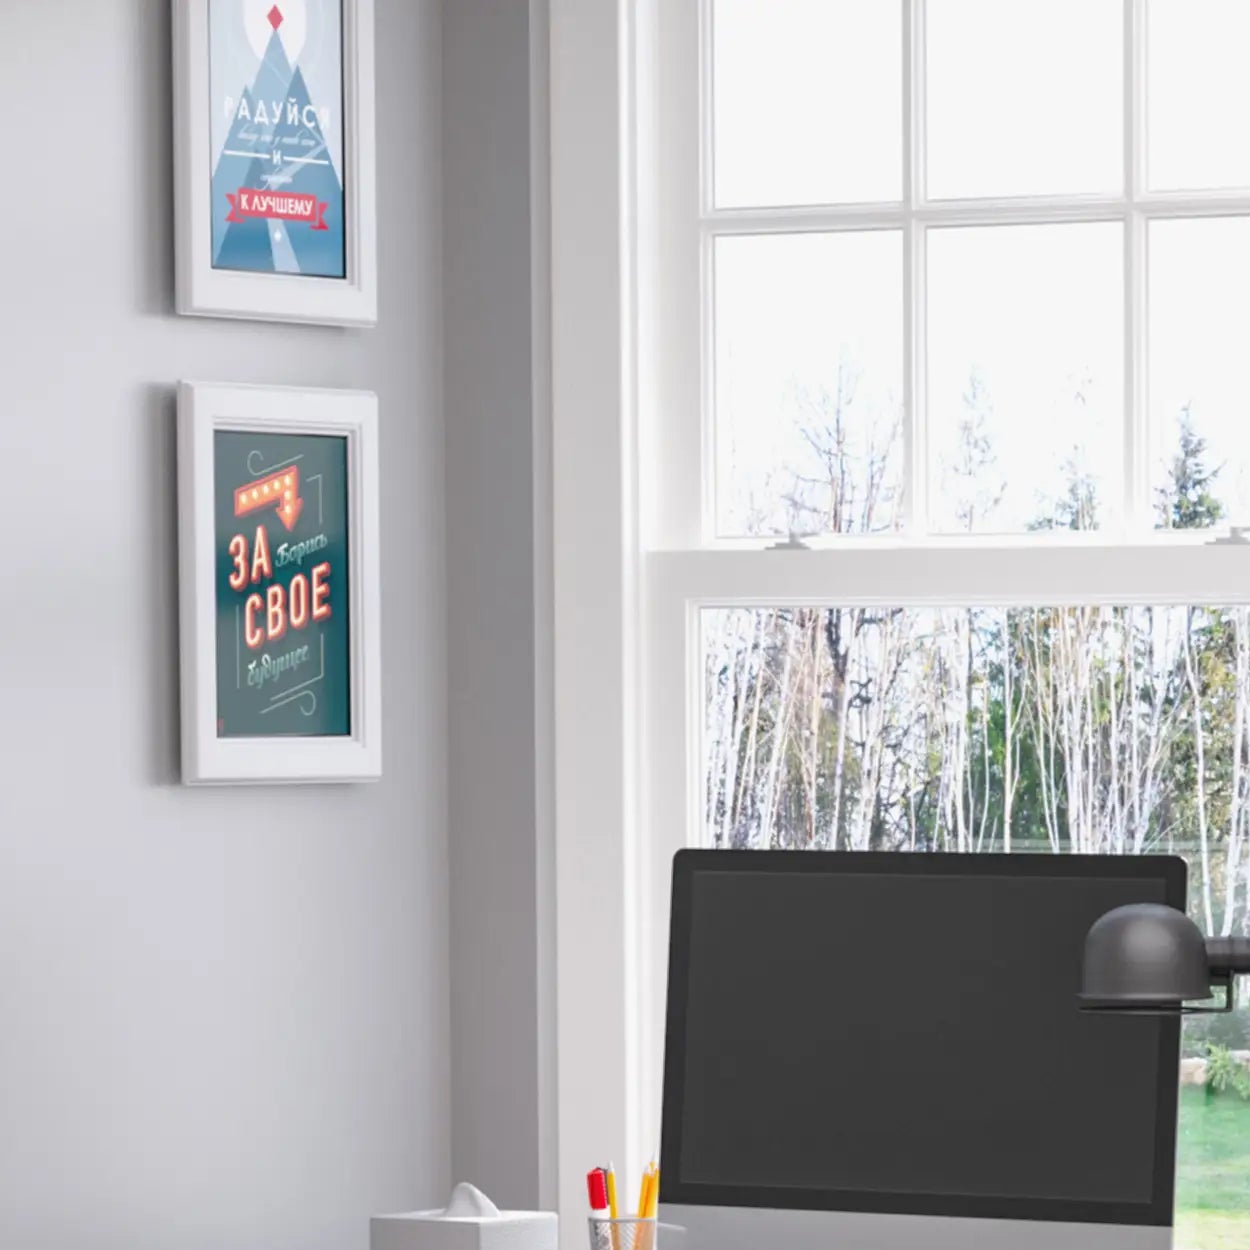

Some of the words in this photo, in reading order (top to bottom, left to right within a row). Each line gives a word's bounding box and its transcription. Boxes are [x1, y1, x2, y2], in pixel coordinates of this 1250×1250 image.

[240, 194, 249, 210] К
[252, 195, 313, 216] ЛУЧШЕМУ
[228, 525, 272, 591] ЗА
[244, 562, 332, 648] СВОЕ
